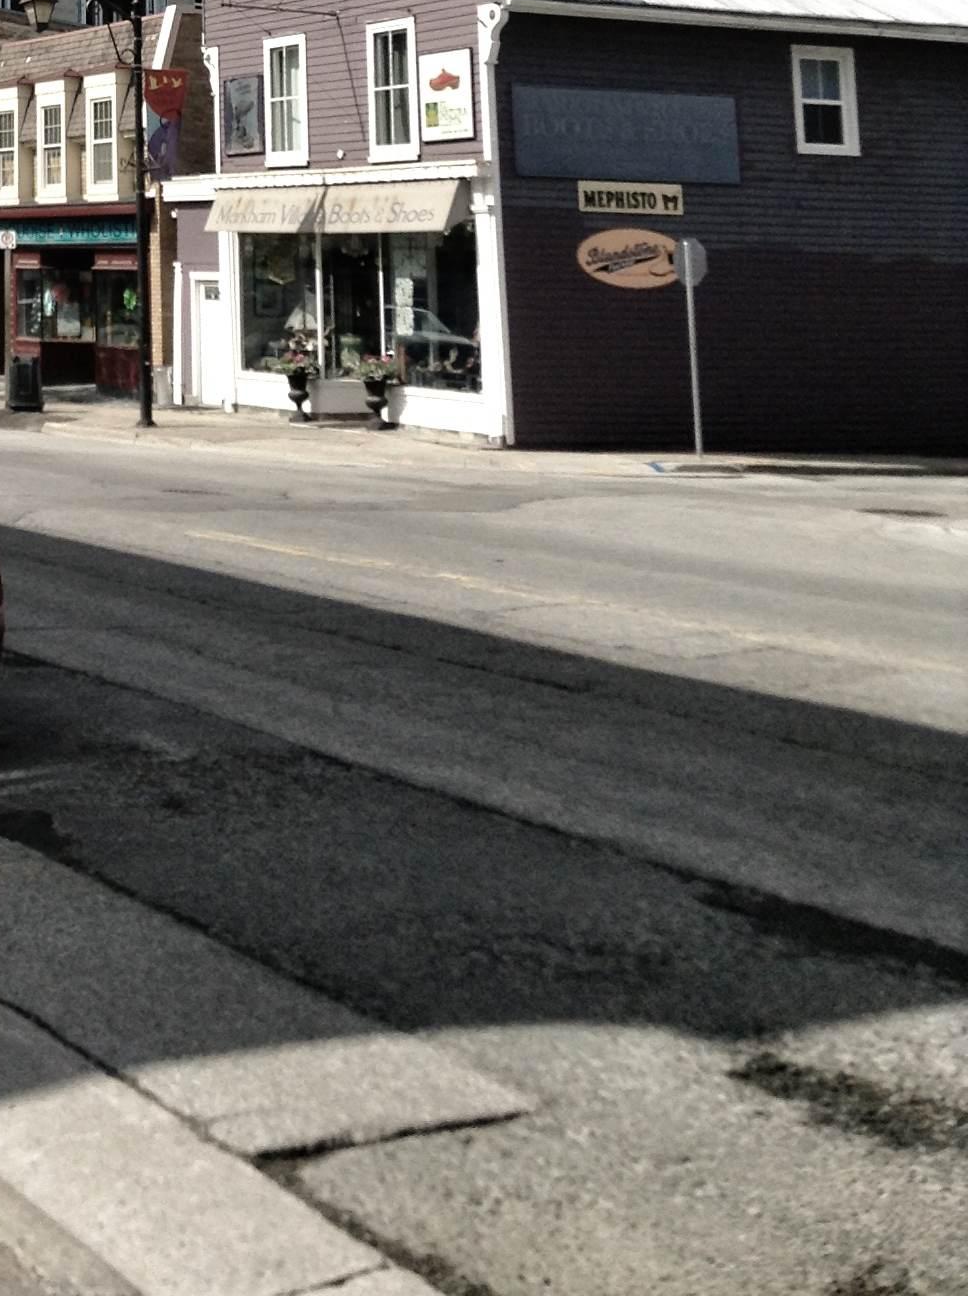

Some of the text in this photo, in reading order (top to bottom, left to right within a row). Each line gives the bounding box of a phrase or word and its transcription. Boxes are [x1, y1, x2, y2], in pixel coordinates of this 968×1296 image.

[216, 204, 277, 225] Markham
[328, 202, 370, 224] Boots
[387, 198, 435, 224] Shoes
[583, 190, 657, 210] MEPHISTO
